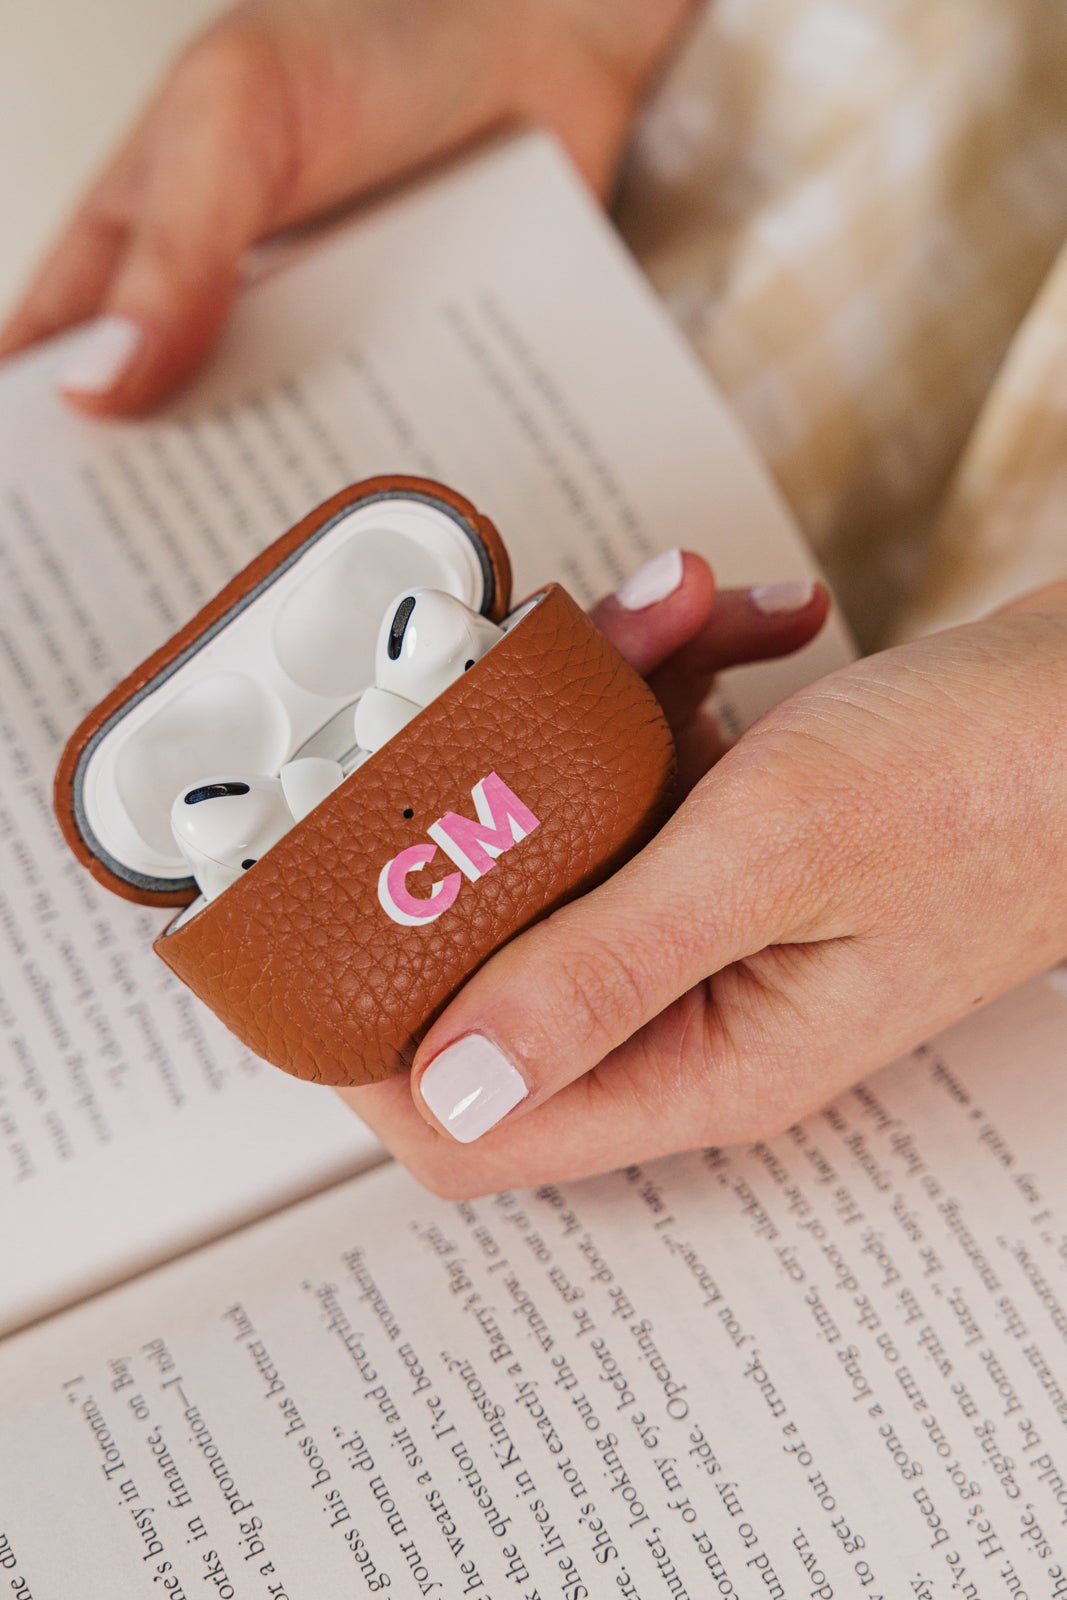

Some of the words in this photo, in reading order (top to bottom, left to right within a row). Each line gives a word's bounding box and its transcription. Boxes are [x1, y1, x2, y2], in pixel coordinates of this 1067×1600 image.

[377, 771, 541, 927] CM
[821, 1244, 859, 1292] door
[572, 1308, 596, 1338] he
[607, 1287, 636, 1321] the
[804, 1285, 841, 1345] time,
[853, 1295, 882, 1332] the
[895, 1287, 925, 1325] his
[997, 1296, 1028, 1340] this
[463, 1293, 514, 1364] Barry’s
[717, 1307, 755, 1348] you
[875, 1332, 900, 1363] on
[247, 1340, 286, 1399] better
[397, 1343, 432, 1396] been
[507, 1362, 523, 1376] a
[551, 1355, 579, 1391] the
[630, 1319, 689, 1421] Opening
[917, 1325, 953, 1378] with
[590, 1338, 636, 1411] before
[743, 1349, 787, 1418] truck,
[836, 1345, 873, 1403] long
[895, 1365, 928, 1412] arm
[979, 1349, 1024, 1417] home
[128, 1394, 150, 1420] on
[279, 1398, 306, 1437] has
[364, 1385, 401, 1424] and
[426, 1397, 457, 1440] I’ve
[440, 1352, 522, 1470] Kingston?”
[515, 1381, 564, 1455] exactly
[571, 1393, 600, 1432] out
[868, 1403, 884, 1418] a
[951, 1382, 979, 1419] me
[68, 1394, 126, 1481] Toronto.”
[332, 1426, 375, 1472] did.”
[391, 1427, 423, 1468] suit
[631, 1412, 660, 1449] eye
[688, 1424, 722, 1476] side.
[782, 1421, 798, 1436] a
[921, 1415, 952, 1459] one
[1017, 1418, 1042, 1453] be
[147, 1426, 192, 1508] finance,
[298, 1437, 332, 1489] boss
[782, 1441, 813, 1467] of
[878, 1424, 924, 1481] gone
[973, 1420, 1021, 1500] caging
[118, 1479, 140, 1505] in
[416, 1470, 432, 1485] a
[451, 1441, 512, 1537] question
[515, 1470, 537, 1498] in
[557, 1458, 588, 1499] not
[595, 1433, 650, 1529] looking
[653, 1458, 682, 1492] my
[807, 1471, 836, 1512] out
[945, 1461, 981, 1500] got
[1029, 1453, 1067, 1526] ould
[323, 1489, 351, 1528] his
[369, 1475, 408, 1537] mom
[666, 1497, 697, 1524] of
[715, 1483, 744, 1517] my
[912, 1487, 950, 1549] been
[131, 1508, 164, 1562] busy
[186, 1515, 208, 1544] in
[238, 1516, 265, 1561] big
[425, 1490, 465, 1558] wears
[529, 1499, 566, 1557] lives
[578, 1503, 619, 1564] She’s
[738, 1523, 759, 1549] to
[831, 1516, 866, 1554] get
[966, 1504, 1005, 1559] He’s
[1020, 1503, 1053, 1559] side,
[259, 1561, 276, 1576] a
[344, 1529, 391, 1592] guess
[399, 1540, 443, 1597] your
[460, 1560, 485, 1595] he
[502, 1544, 530, 1584] the
[558, 1557, 589, 1600] She
[792, 1527, 834, 1600] down.
[854, 1560, 875, 1587] to
[1048, 1565, 1067, 1600] he
